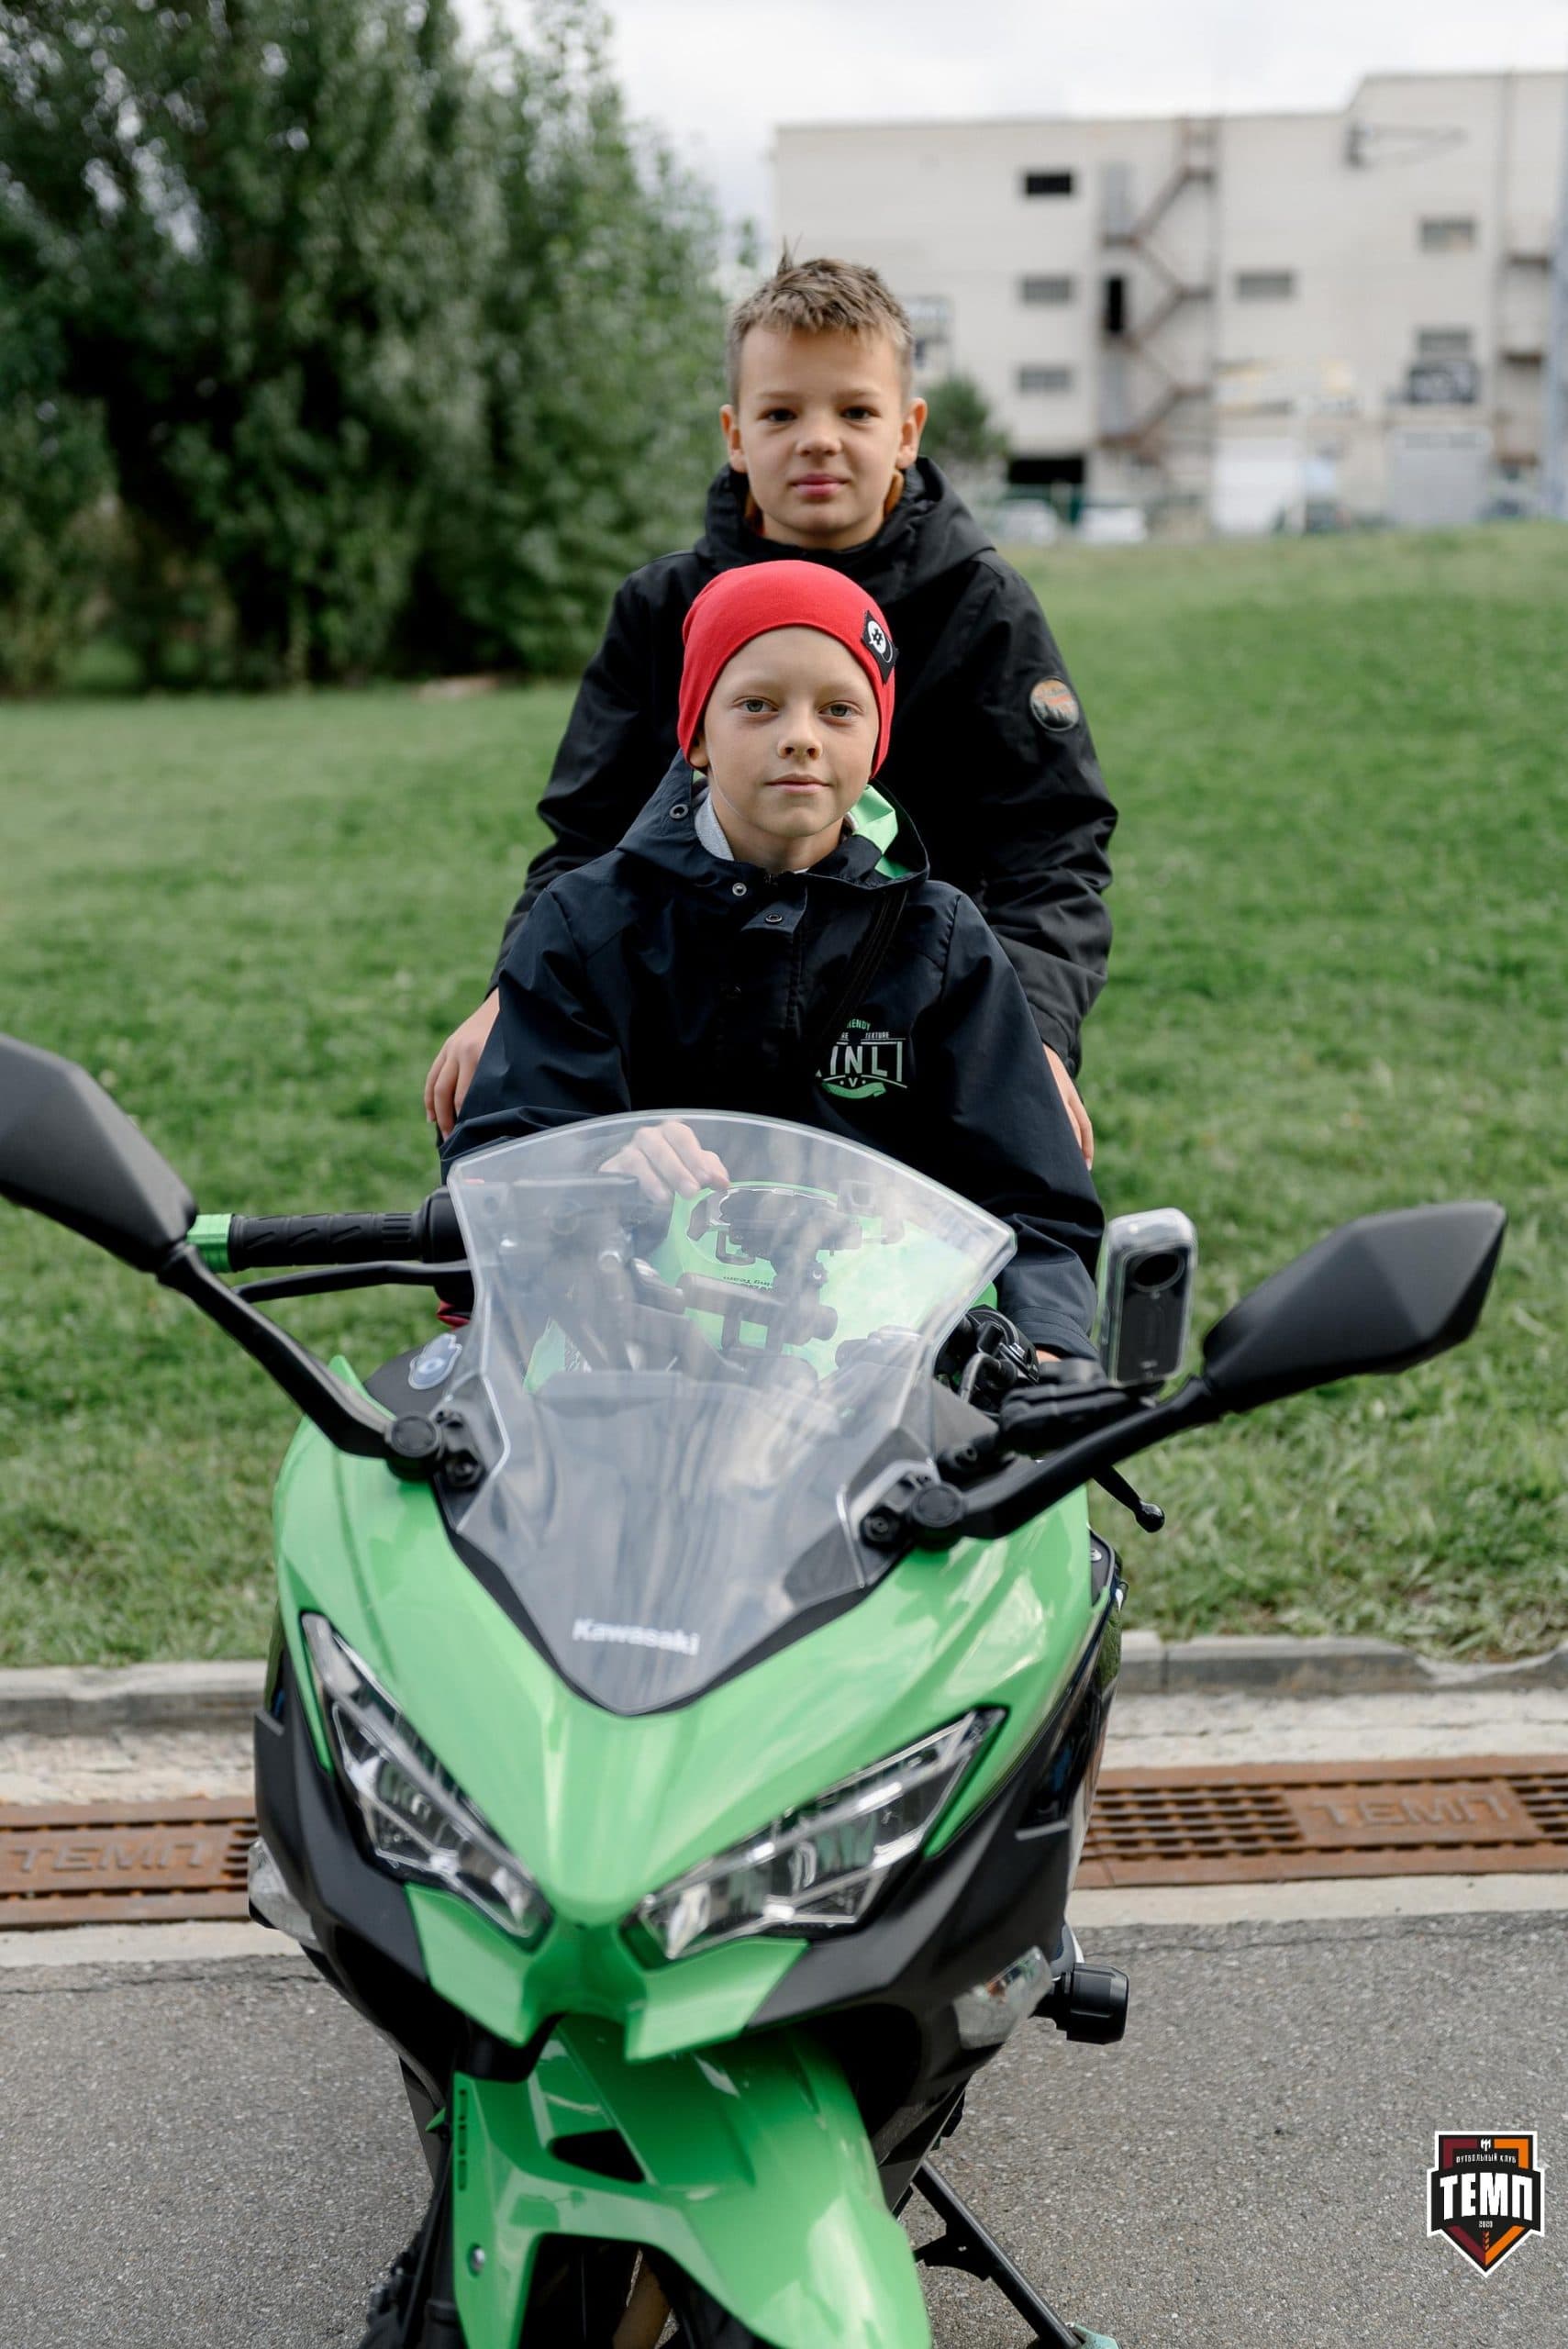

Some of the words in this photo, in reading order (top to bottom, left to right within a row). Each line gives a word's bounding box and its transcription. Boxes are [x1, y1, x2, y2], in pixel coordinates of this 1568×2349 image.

[573, 1618, 700, 1655] Kawasaki
[1306, 1793, 1510, 1827] ТЕМП
[9, 1839, 206, 1874] ТЕМП
